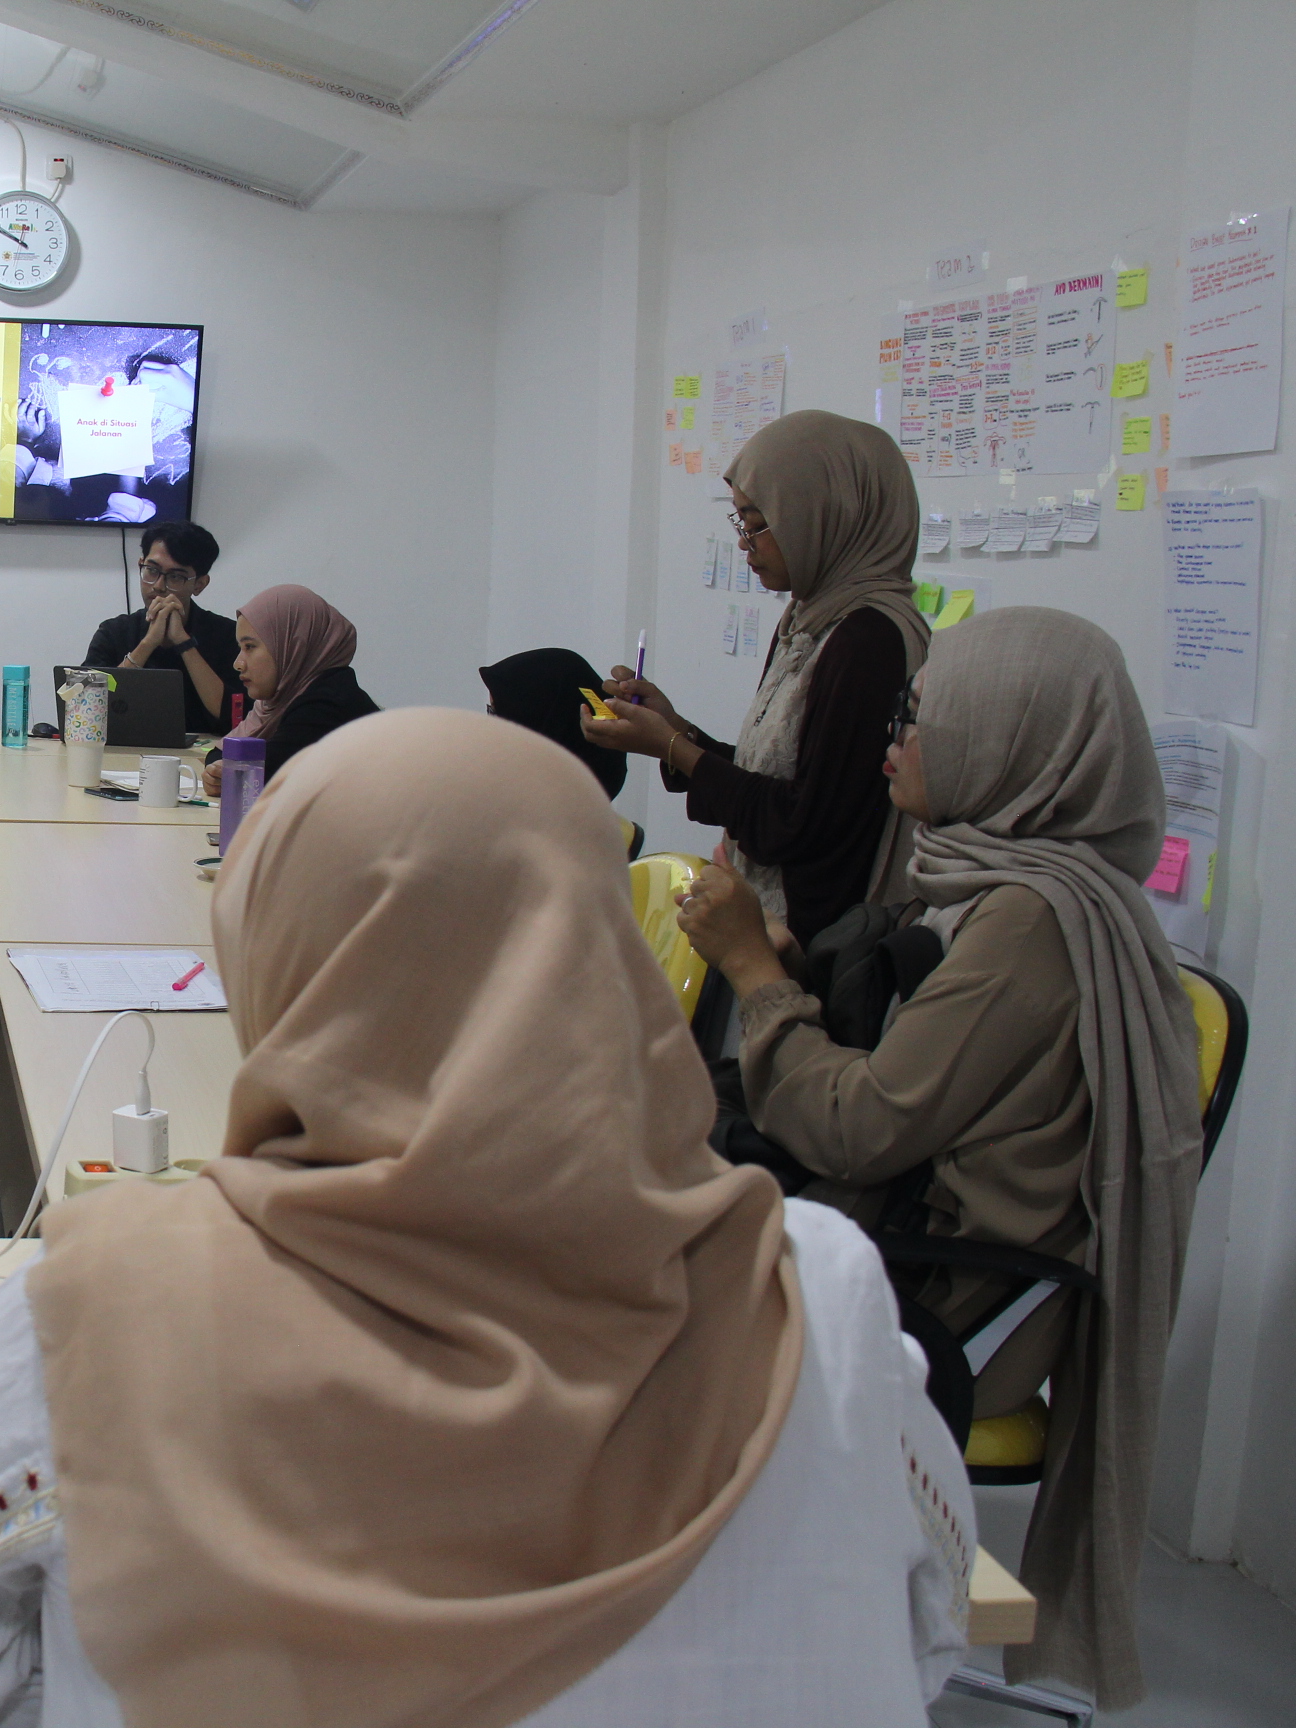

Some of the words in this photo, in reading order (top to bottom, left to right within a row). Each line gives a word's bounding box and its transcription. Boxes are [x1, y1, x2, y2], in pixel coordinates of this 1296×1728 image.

[0, 208, 8, 218] 11
[15, 204, 27, 215] 12
[45, 220, 54, 231] 2
[49, 237, 58, 249] 3
[44, 254, 52, 264] 4
[0, 265, 9, 276] 7
[15, 269, 24, 280] 6
[31, 266, 40, 276] 5
[77, 418, 98, 426] Anak
[90, 429, 122, 438] Jalanan
[8, 687, 17, 698] MY
